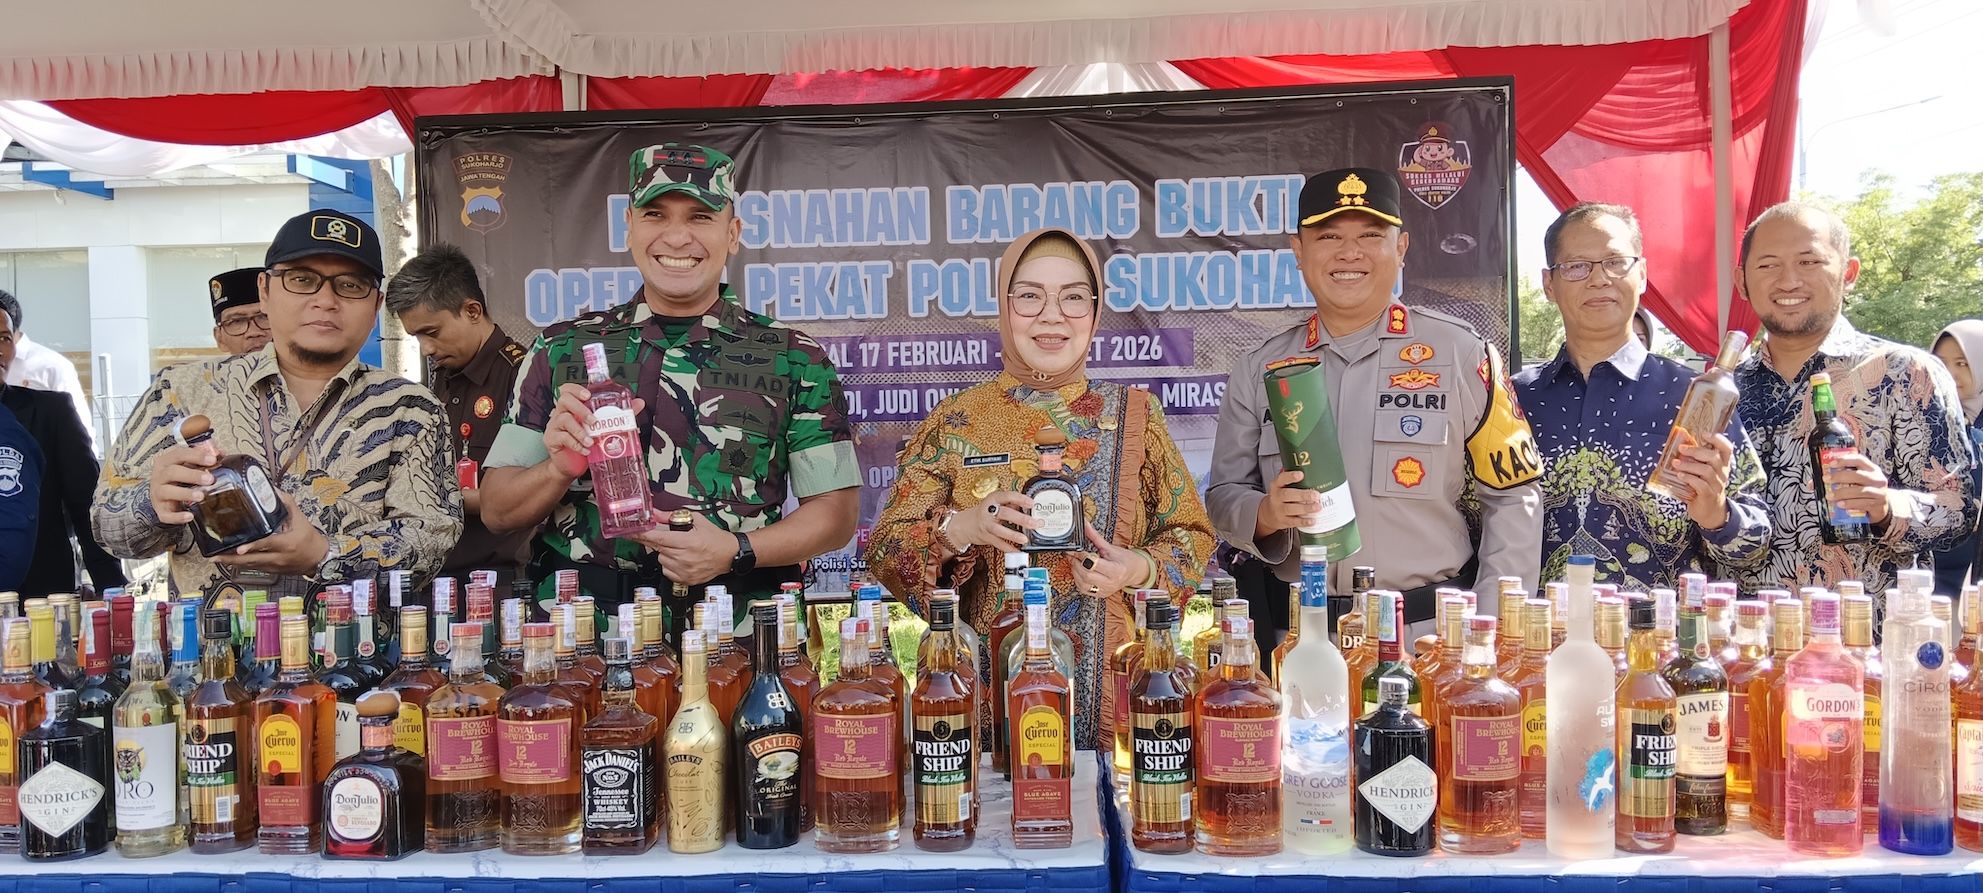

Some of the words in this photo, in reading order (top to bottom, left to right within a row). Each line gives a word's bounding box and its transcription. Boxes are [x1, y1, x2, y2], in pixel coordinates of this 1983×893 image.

[459, 154, 505, 164] POLRES
[461, 161, 504, 170] SUKOHARJO
[460, 174, 478, 182] JAWA
[479, 172, 505, 181] TENGAH
[946, 180, 1140, 244] BARANG
[1154, 174, 1306, 238] BUKTI
[744, 260, 893, 321] PEKAT
[859, 342, 881, 367] 17
[887, 340, 988, 367] FEBRUARI
[1111, 335, 1163, 361] 2026
[710, 371, 747, 387] TNI
[754, 375, 783, 392] AD
[873, 389, 919, 414] JUDI
[1379, 393, 1447, 410] POLRI
[1293, 451, 1311, 466] 12
[814, 557, 847, 571] Polisi
[1680, 700, 1724, 716] JAMES
[461, 720, 491, 730] ROYAL
[508, 725, 535, 733] ROYAL
[824, 726, 878, 734] BREWHOUSE
[835, 719, 865, 727] ROYAL
[1233, 722, 1263, 731] ROYAL
[1489, 721, 1514, 730] ROYAL
[447, 726, 493, 737] BREWHOU
[1025, 726, 1058, 740] Cuervo
[1220, 729, 1274, 738] BREWHOUSE
[265, 734, 296, 748] Cuervo
[471, 740, 483, 752] 12
[754, 736, 802, 754] BAILEYS
[844, 740, 856, 753] 12
[915, 739, 970, 755] FRIEND
[1135, 737, 1191, 754] FRIEND
[1498, 740, 1508, 753] 12
[516, 745, 527, 757] 12
[1243, 742, 1256, 757] 12
[584, 755, 605, 773] JACK
[604, 753, 640, 772] DANIEL'S
[670, 755, 702, 765] BAILEYS
[923, 756, 962, 772] SHIP
[1144, 755, 1185, 770] SHIP
[1283, 774, 1304, 787] GREY
[1310, 775, 1347, 788] GOOSE
[21, 787, 97, 804] HENDRICK'S
[592, 787, 629, 796] Tennessee
[760, 784, 797, 793] ORIGINAL
[1296, 789, 1334, 799] VODKA
[44, 807, 70, 815] GIN
